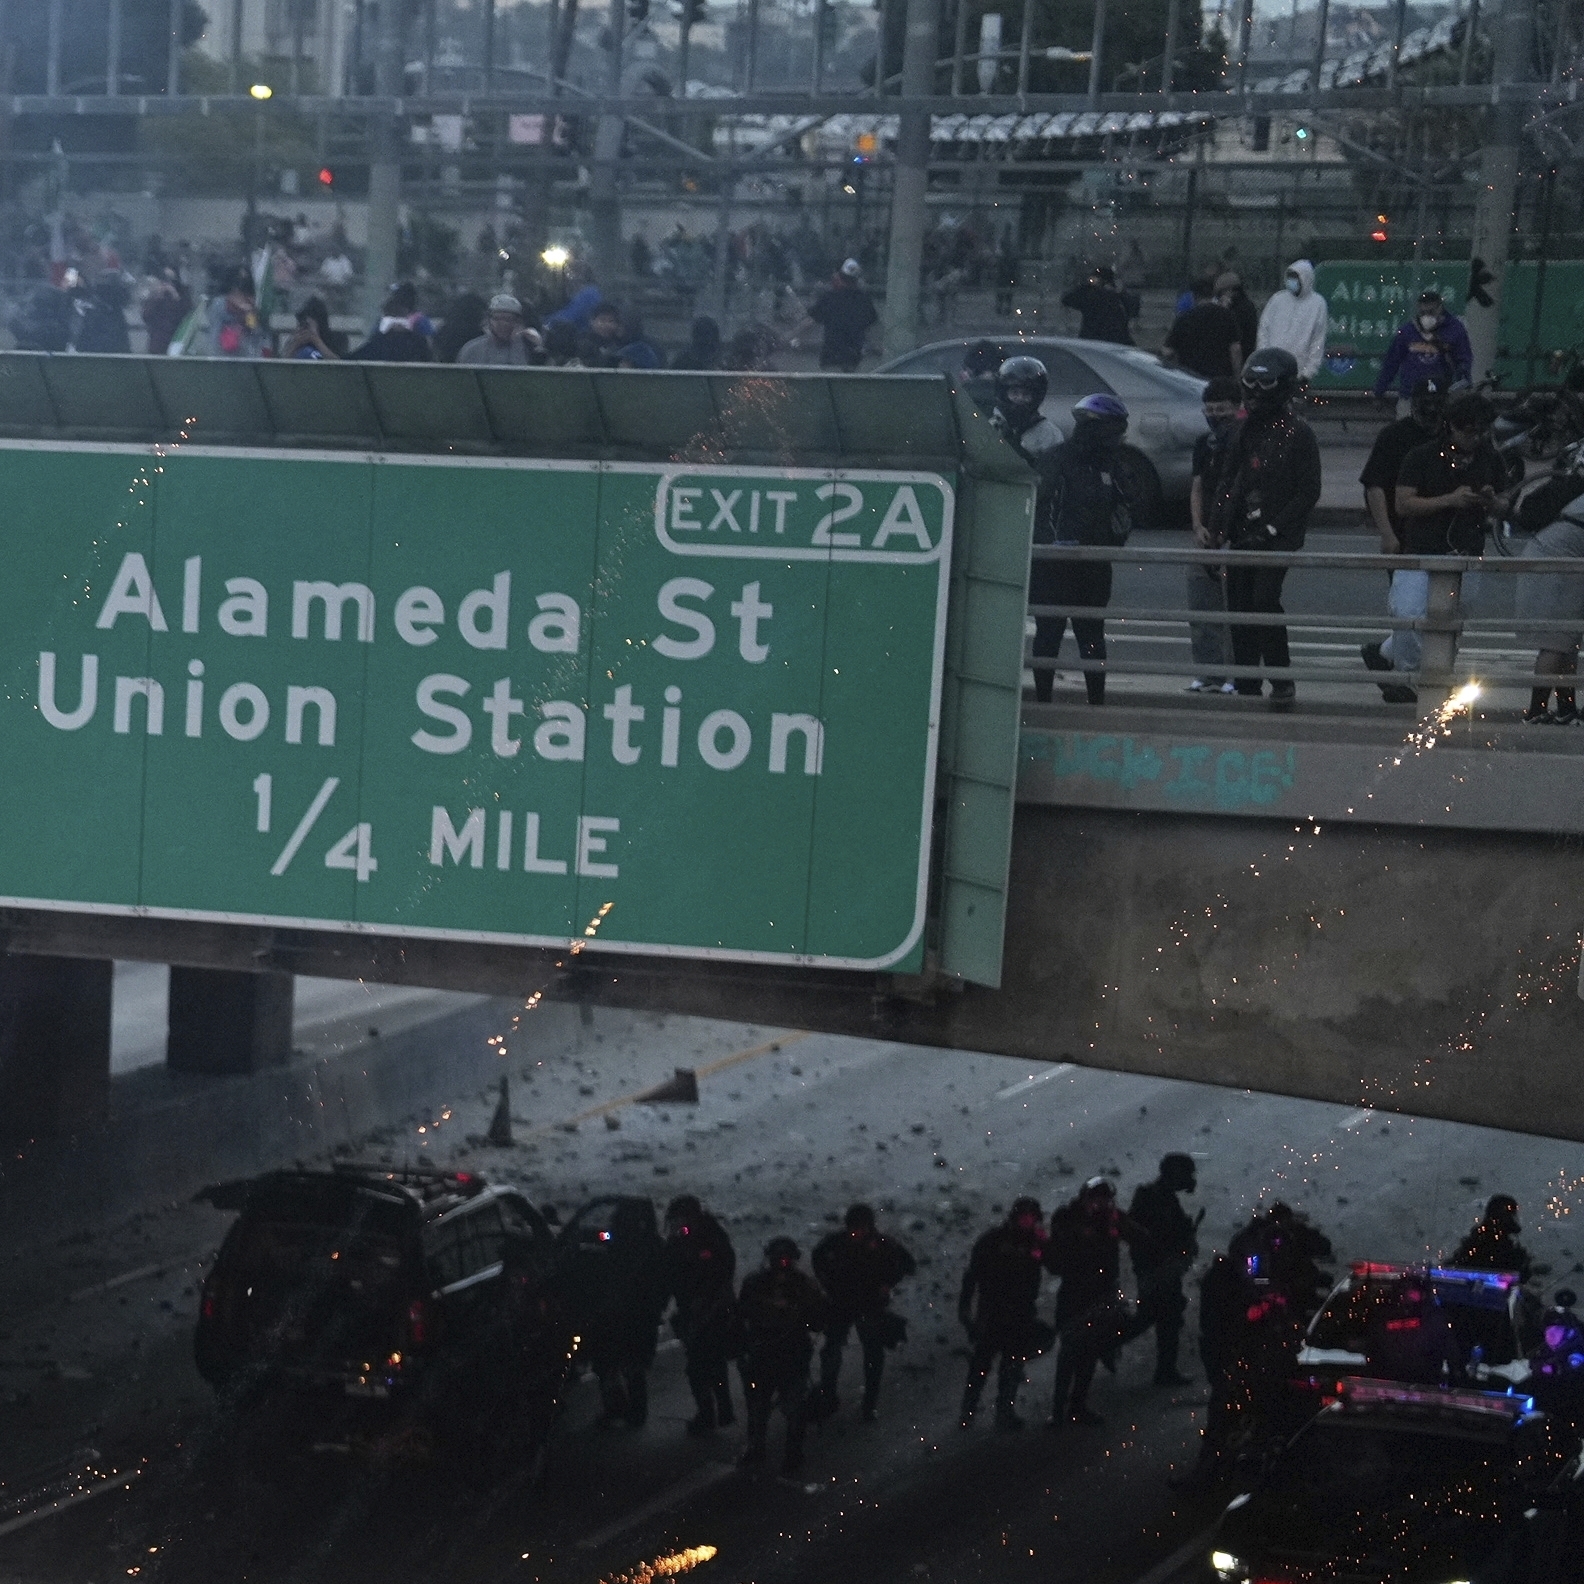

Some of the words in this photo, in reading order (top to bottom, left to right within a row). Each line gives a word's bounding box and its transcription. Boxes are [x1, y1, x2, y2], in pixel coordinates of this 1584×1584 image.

[1332, 282, 1456, 302] Alama
[670, 488, 799, 535] EXIT
[810, 485, 935, 552] 2A
[96, 552, 582, 655] Alameda
[654, 576, 773, 663] St
[36, 650, 339, 747] Union
[411, 672, 826, 776] Station
[252, 774, 377, 883] 1/4
[430, 805, 620, 879] MILE
